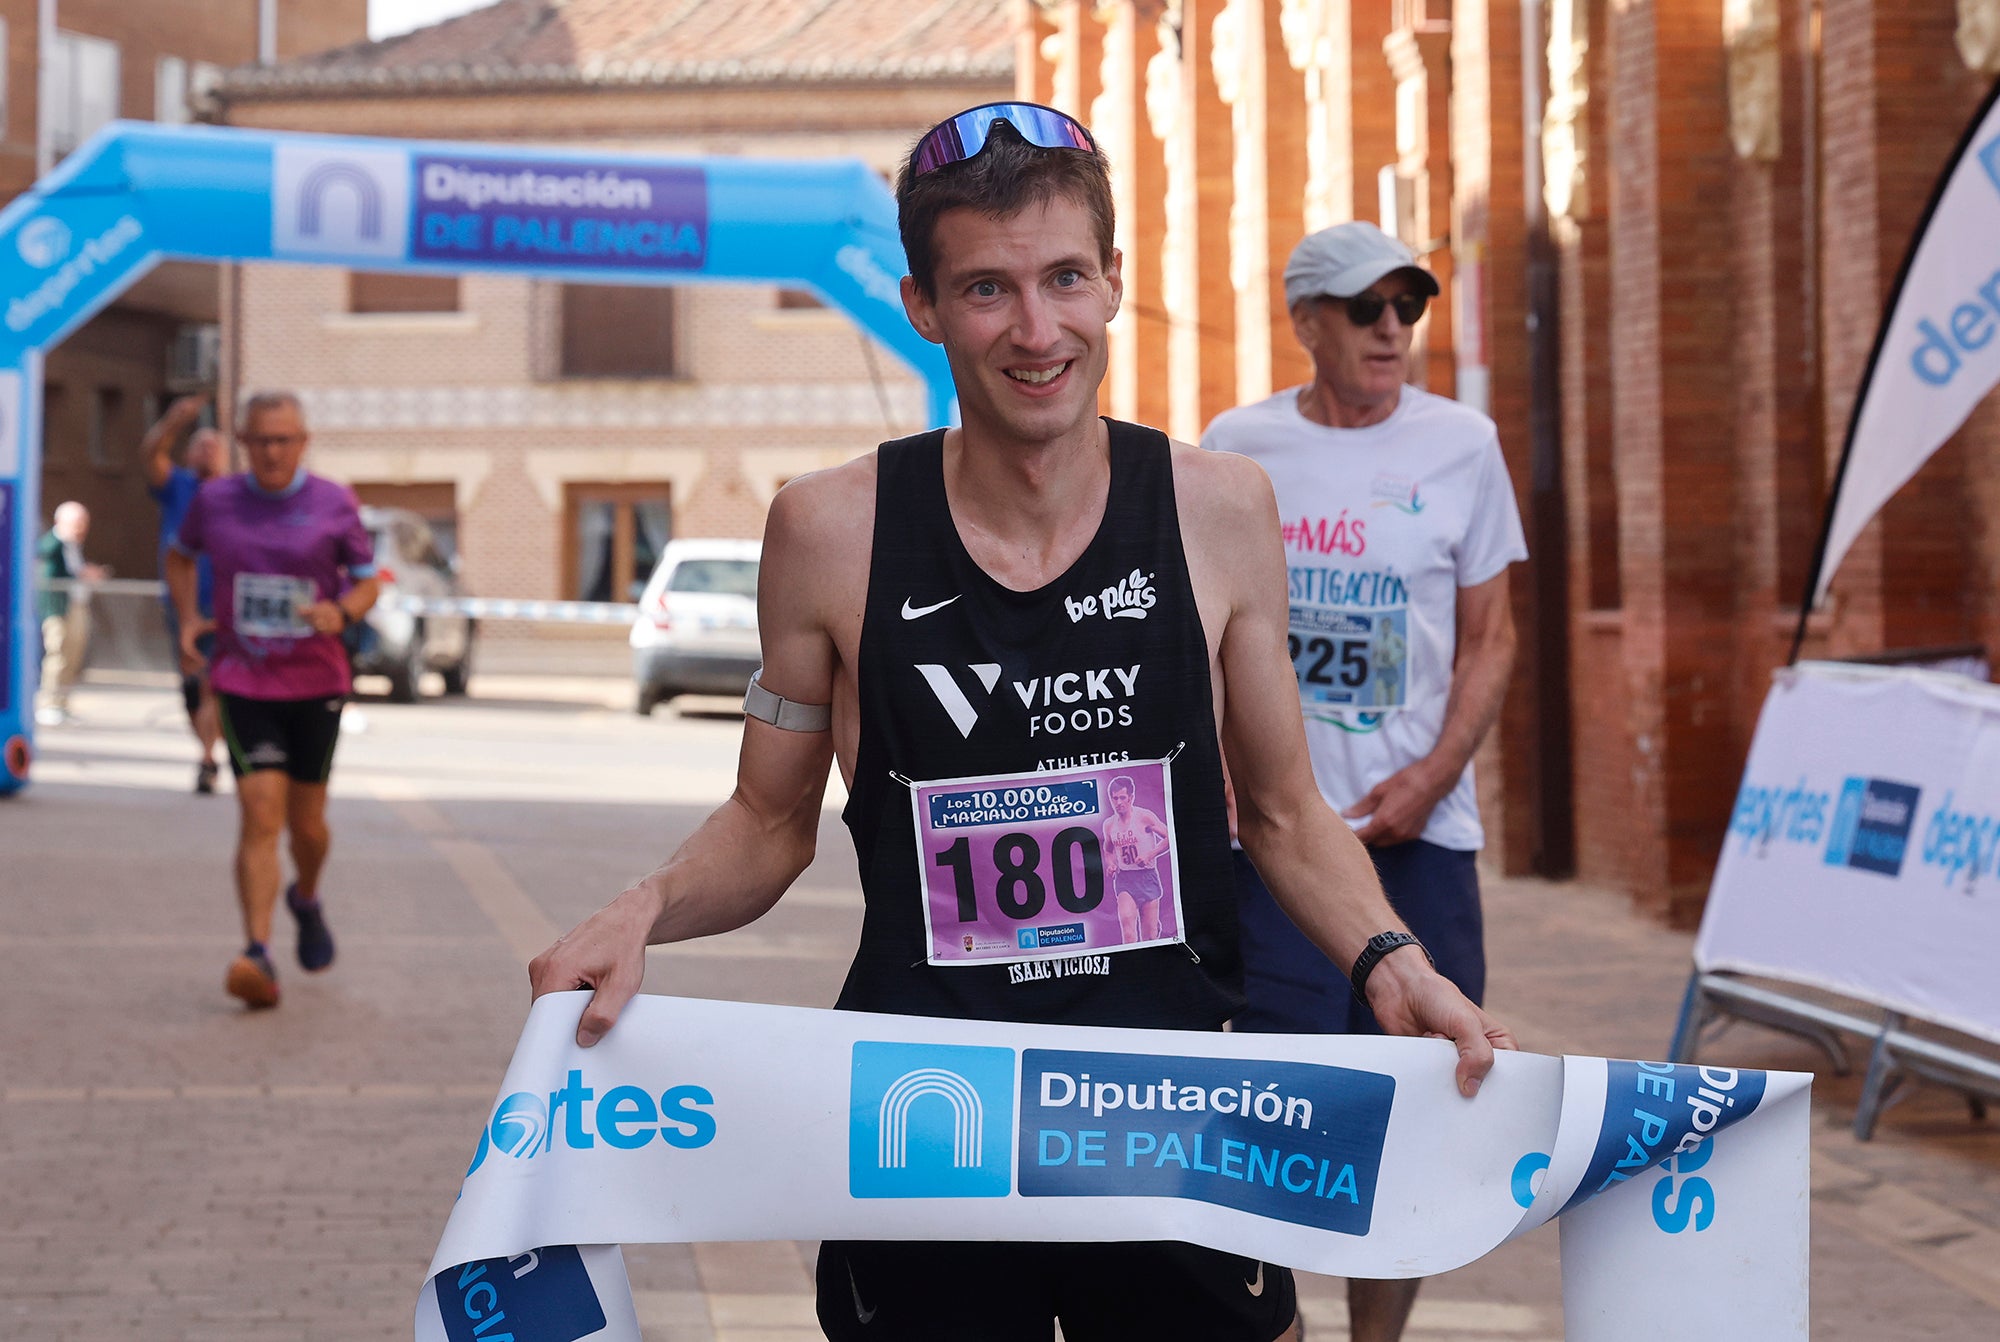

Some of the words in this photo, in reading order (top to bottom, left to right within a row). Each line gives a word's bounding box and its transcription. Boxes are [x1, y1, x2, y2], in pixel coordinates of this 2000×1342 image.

[423, 163, 652, 209] Diputación
[423, 212, 482, 248] DE
[493, 215, 701, 257] PALENCIA
[1287, 563, 1409, 607] STIGACIÓN
[1012, 664, 1141, 710] VICKY
[1030, 705, 1133, 737] FOODS
[1036, 750, 1130, 772] ATHLETICS
[942, 806, 1029, 825] MARIANO
[1034, 800, 1087, 817] HARO
[947, 799, 972, 809] Los
[971, 786, 1051, 810] 10.000
[1051, 794, 1068, 804] de
[936, 826, 1105, 922] 180
[1039, 926, 1075, 939] Diputación
[1051, 934, 1084, 944] PALENCIA
[1008, 961, 1053, 984] ISAAC
[1052, 956, 1111, 979] VICIOSA
[1041, 1071, 1313, 1130] Diputación
[1038, 1129, 1107, 1167] DE
[1125, 1131, 1360, 1205] PALENCIA
